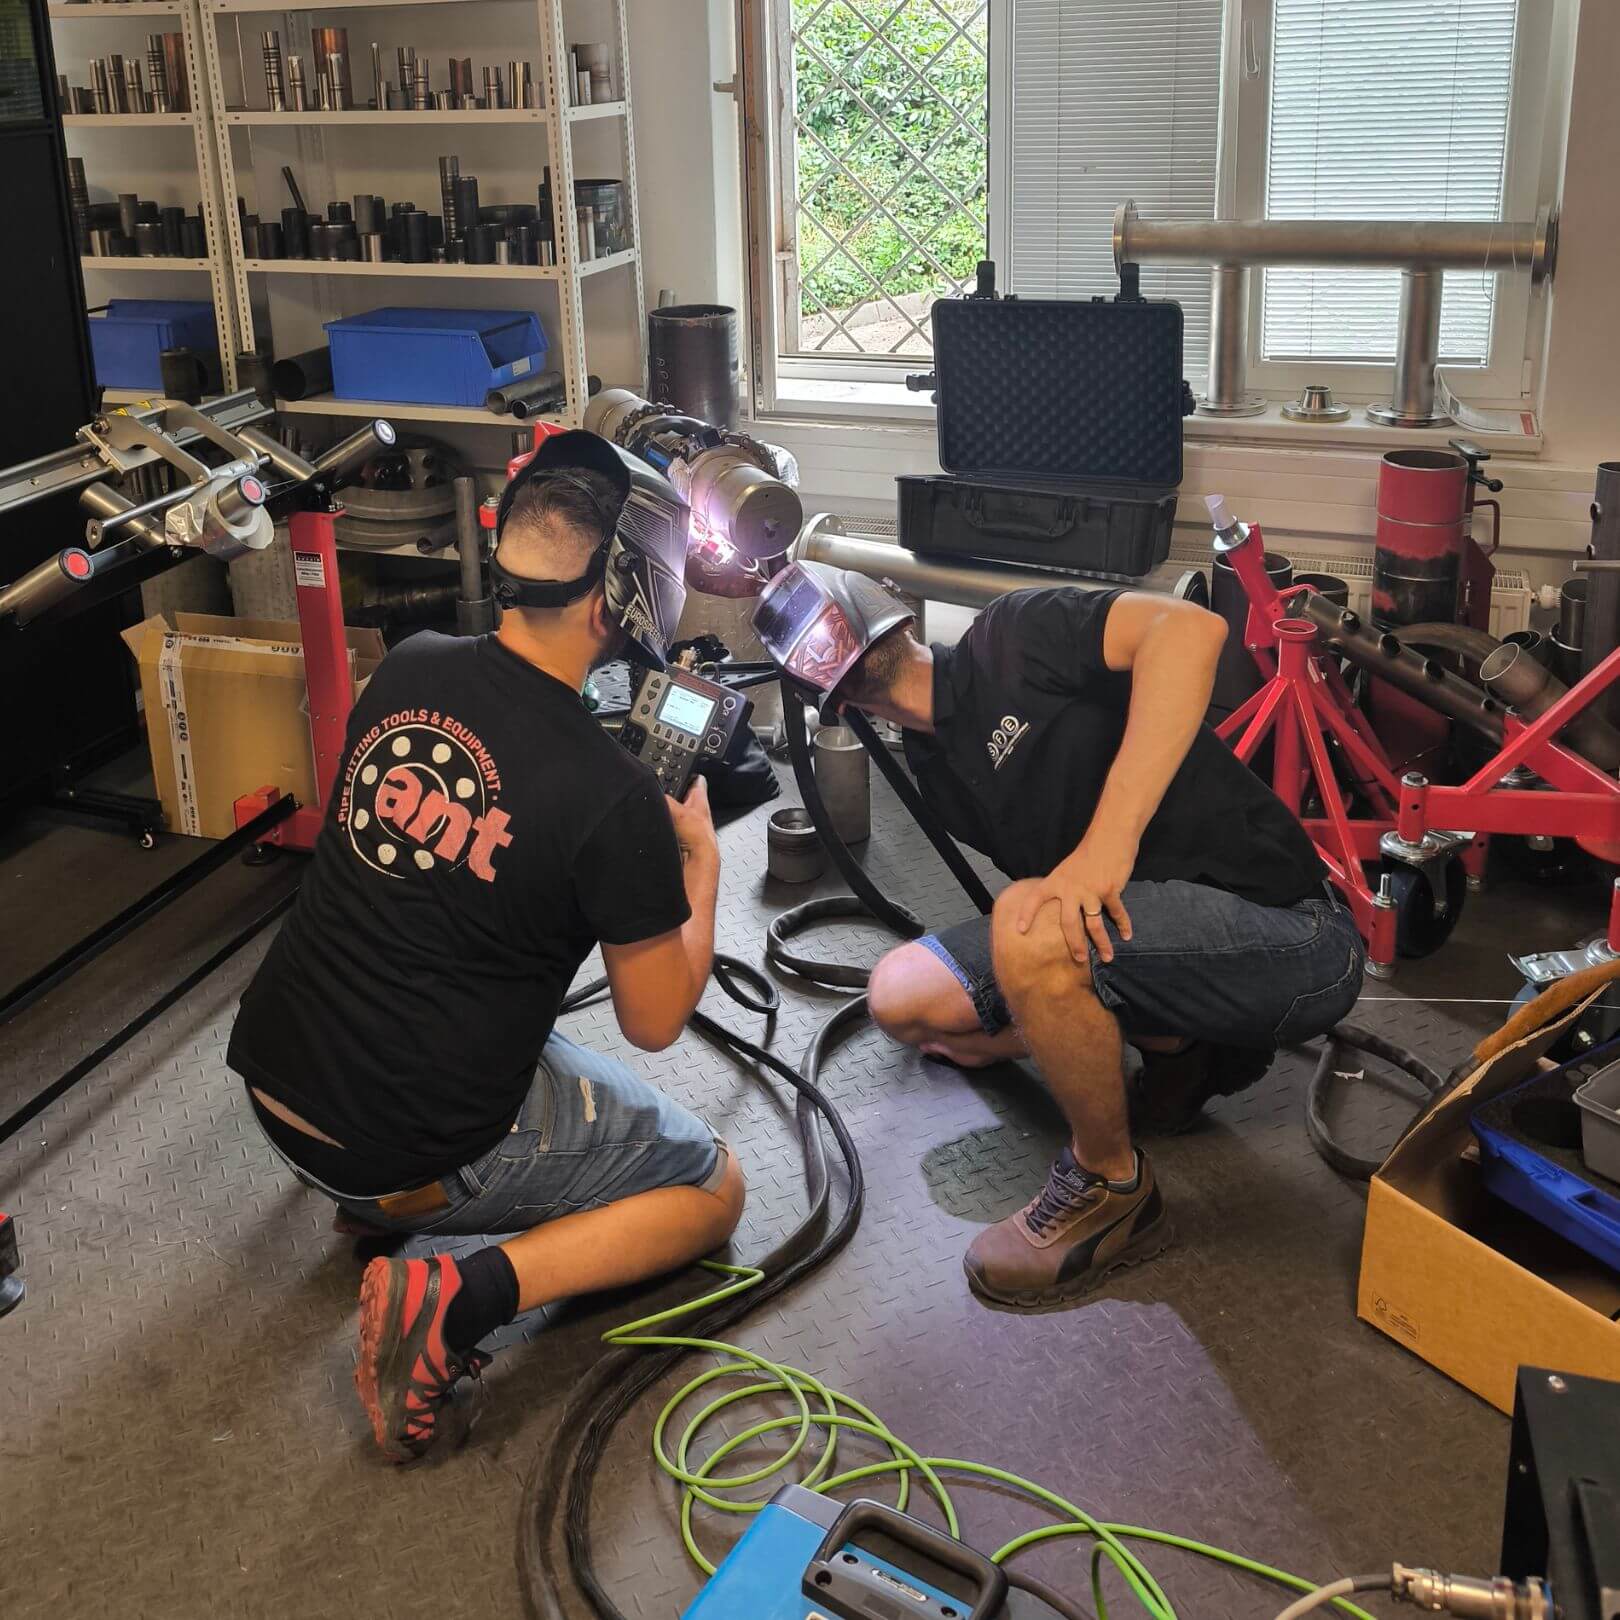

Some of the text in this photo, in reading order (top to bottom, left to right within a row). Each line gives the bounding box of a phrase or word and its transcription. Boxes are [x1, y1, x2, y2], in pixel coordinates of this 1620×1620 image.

[338, 709, 502, 823] PIPE FITTING TOOLS & EQUIPMENT
[376, 767, 514, 883] ant
